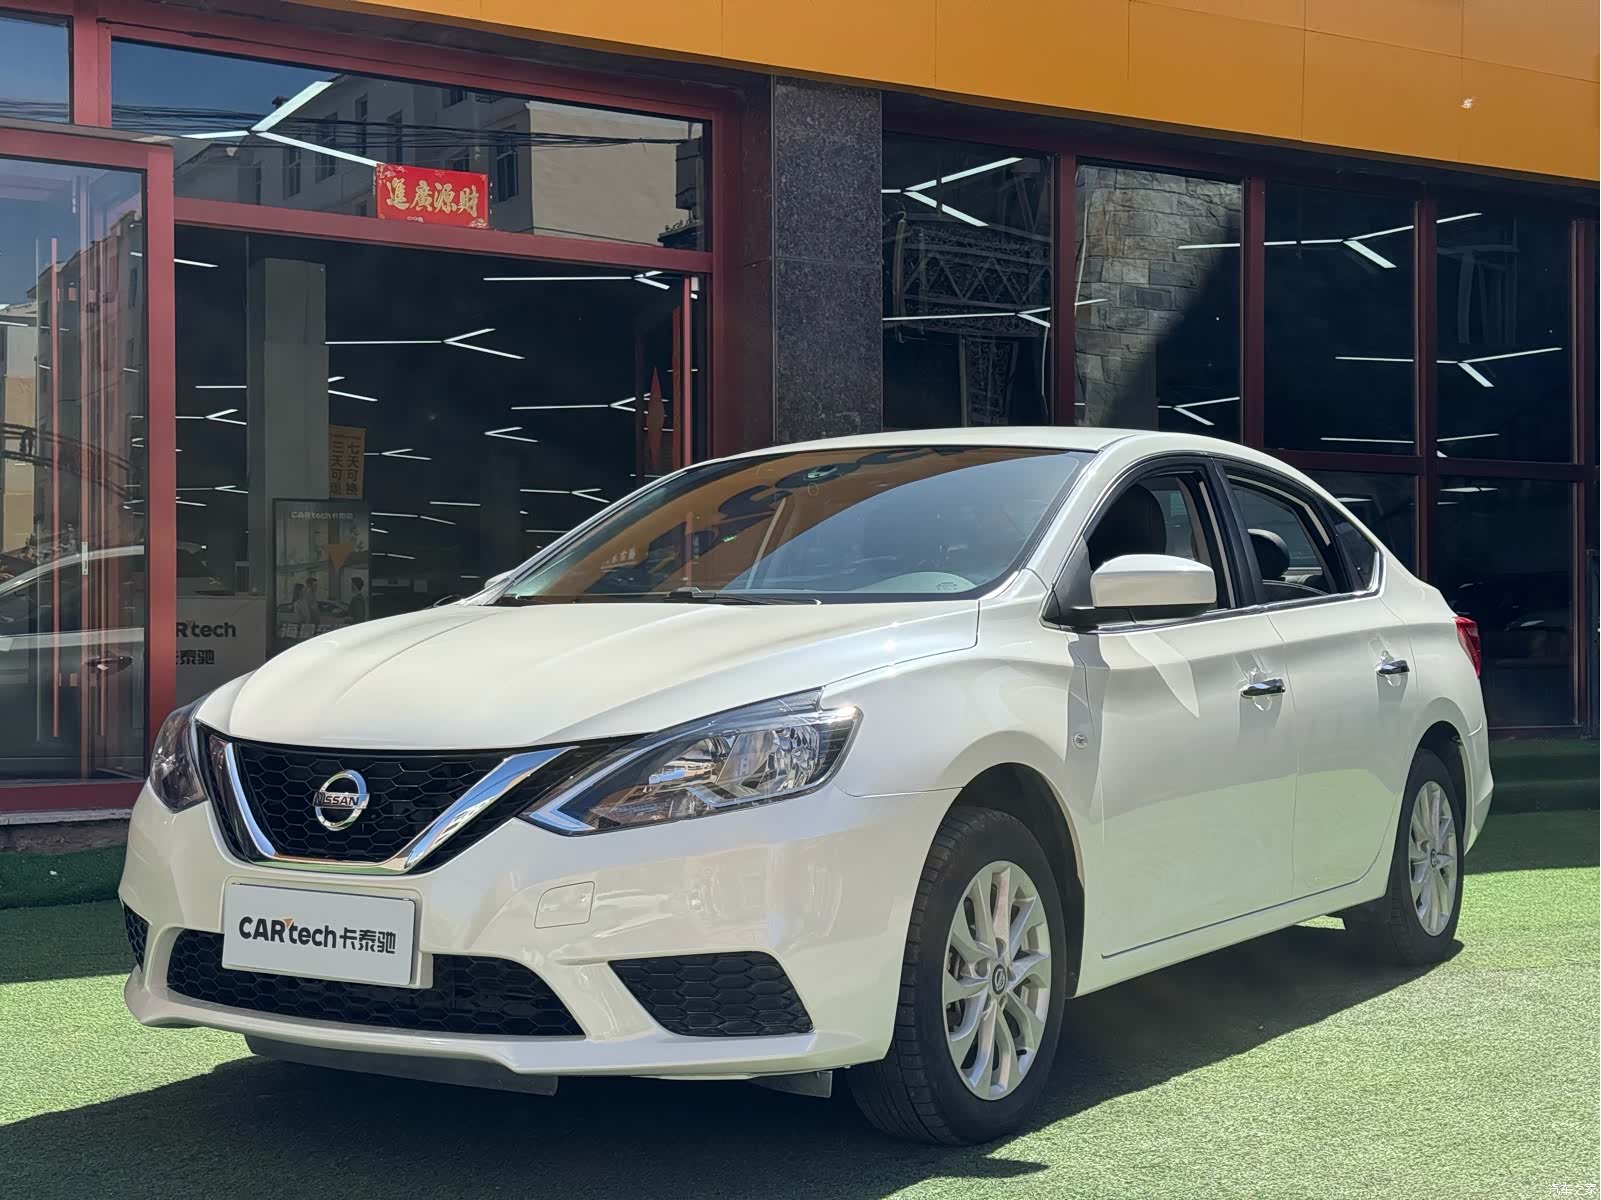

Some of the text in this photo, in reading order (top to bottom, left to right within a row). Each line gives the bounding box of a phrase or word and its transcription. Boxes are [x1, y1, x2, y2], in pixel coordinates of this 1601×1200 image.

[176, 649, 215, 665] 泰驰
[314, 792, 360, 806] NISSAN
[238, 916, 396, 954] CARtech 卡泰驰
